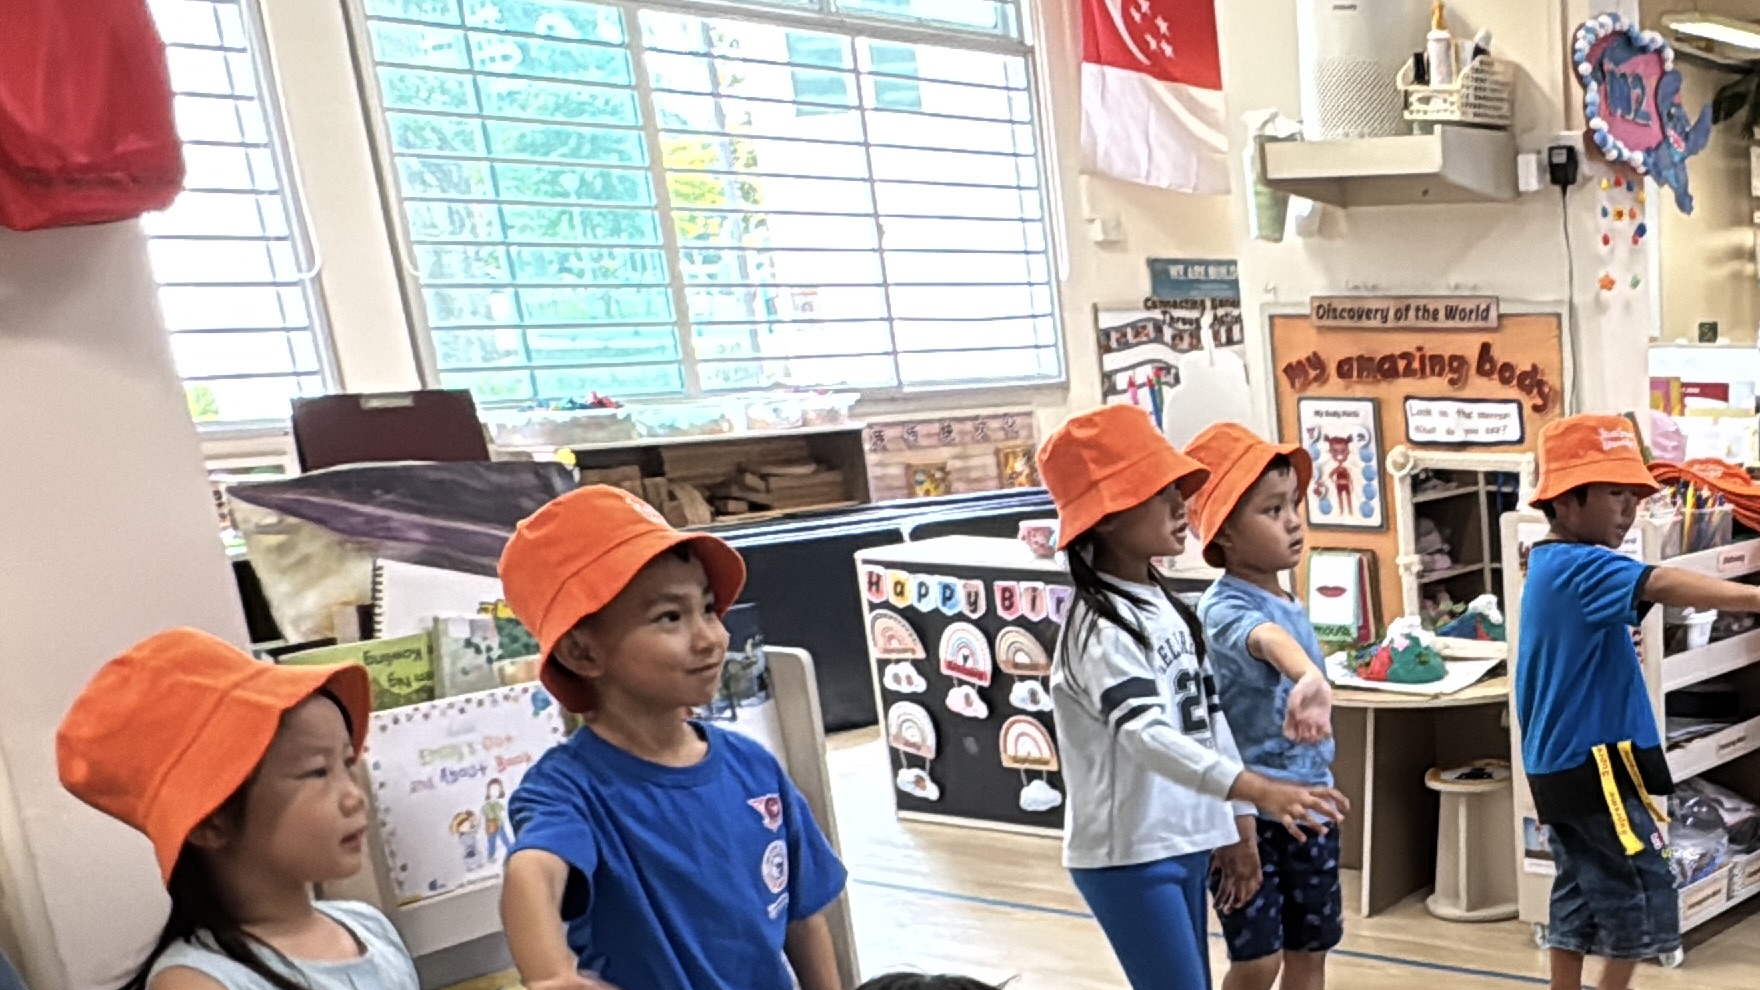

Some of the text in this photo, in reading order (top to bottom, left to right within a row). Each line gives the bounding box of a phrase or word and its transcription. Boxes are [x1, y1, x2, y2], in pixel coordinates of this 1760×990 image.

[1315, 302, 1492, 324] Discovery of the World
[1336, 346, 1470, 388] amazing
[1476, 341, 1555, 414] body
[867, 570, 980, 614] Happy
